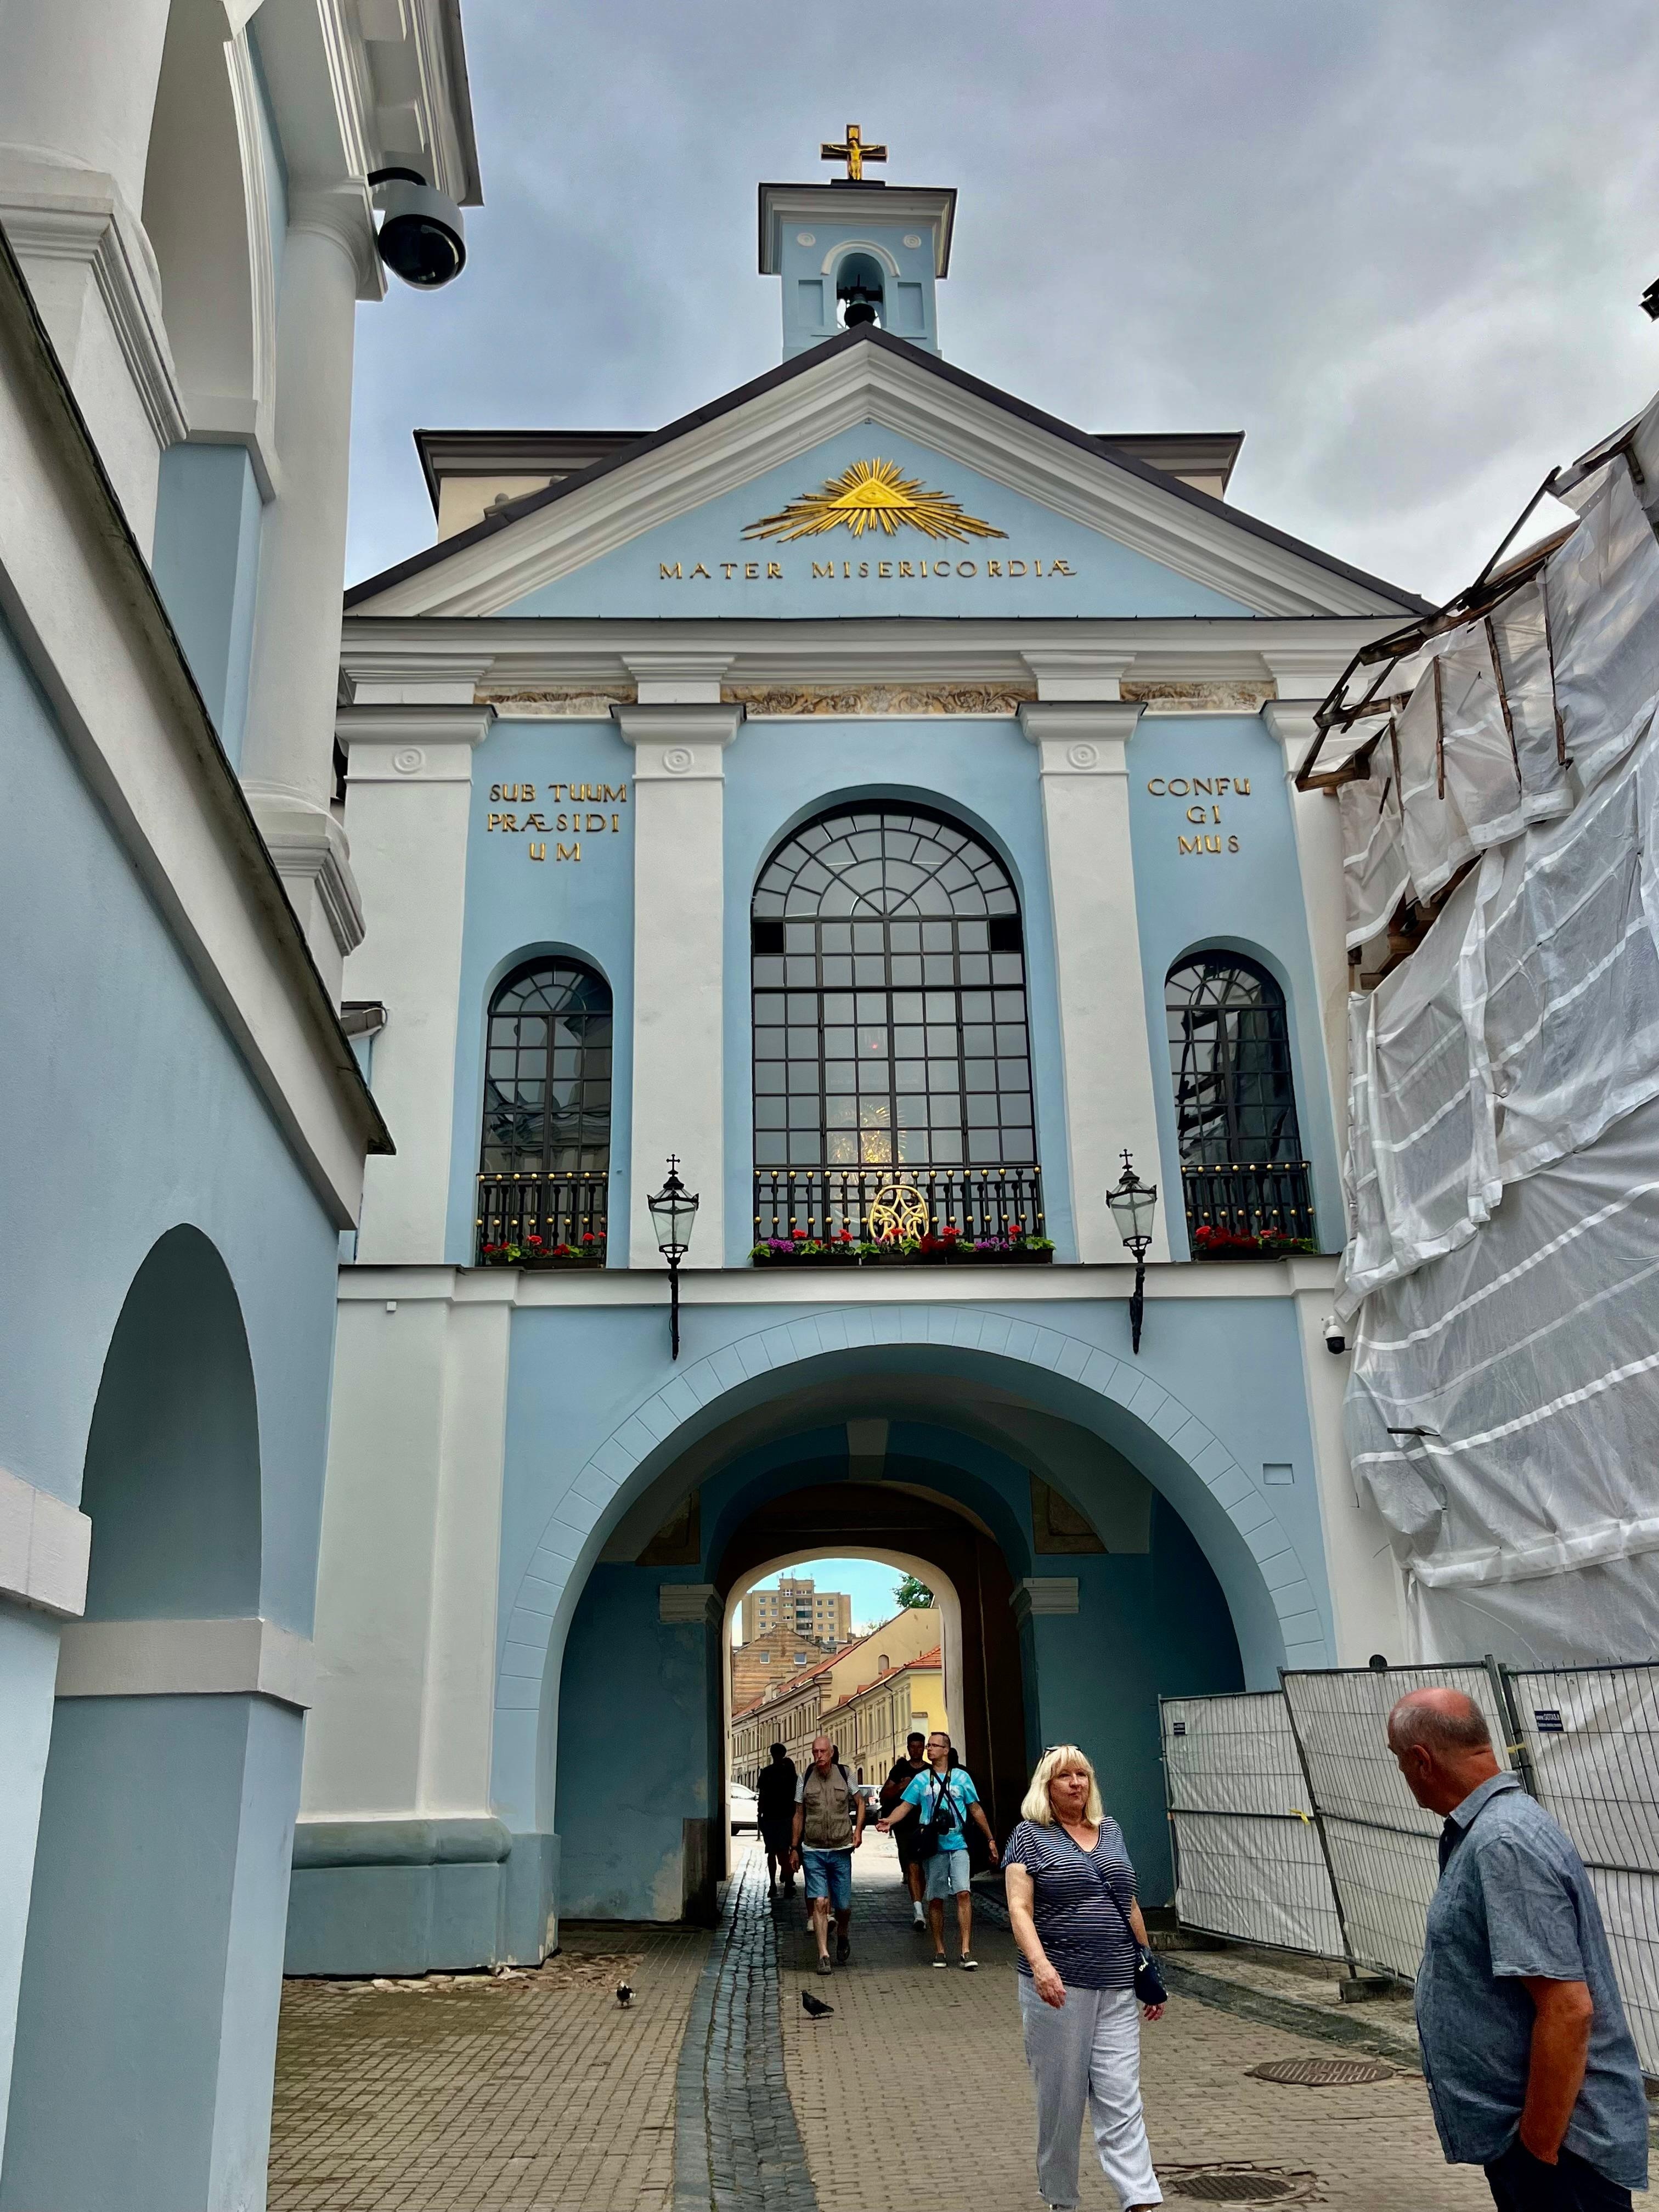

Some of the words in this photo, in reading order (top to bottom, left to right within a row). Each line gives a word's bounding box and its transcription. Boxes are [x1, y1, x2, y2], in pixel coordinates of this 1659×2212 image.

[660, 562, 783, 579] MATER
[490, 784, 536, 802] SUB
[548, 784, 627, 802] TUUM
[1148, 777, 1251, 796] CONFU
[1187, 805, 1221, 824] GI
[529, 842, 581, 861] UM
[1178, 834, 1239, 855] MUS
